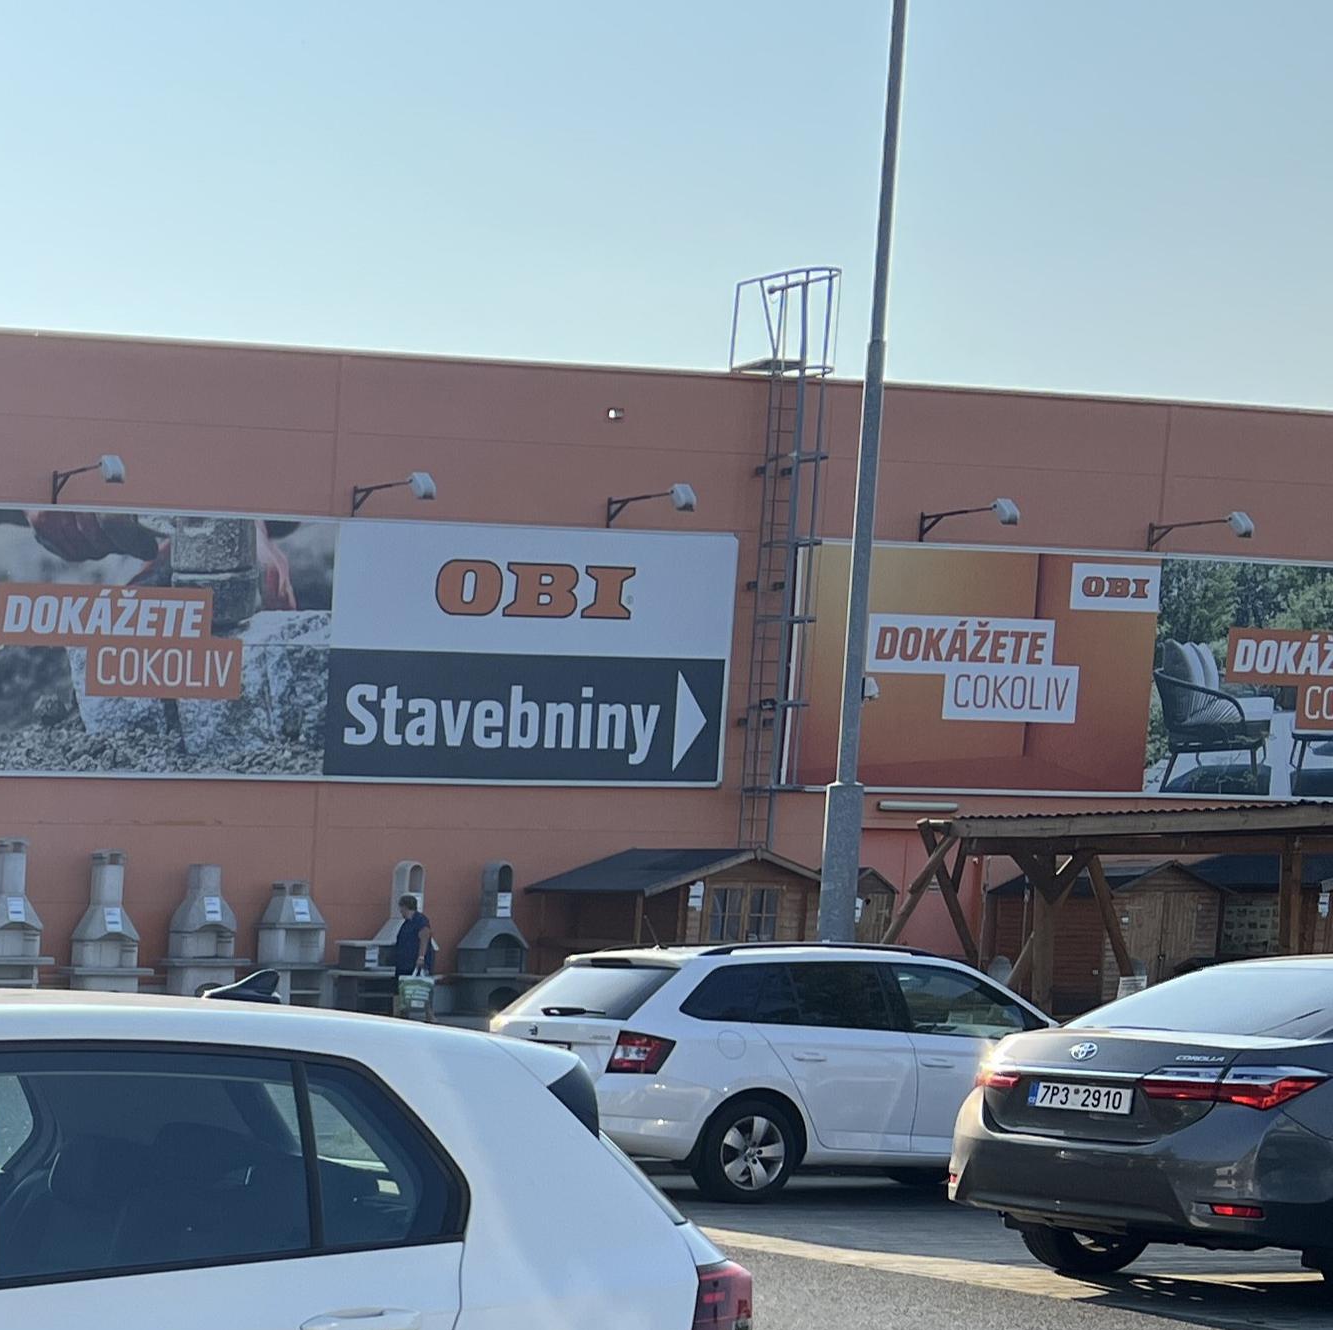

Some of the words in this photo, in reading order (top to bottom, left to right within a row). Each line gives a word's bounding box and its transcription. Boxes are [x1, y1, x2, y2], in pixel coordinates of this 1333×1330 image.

[435, 558, 636, 620] OBI
[1081, 575, 1151, 599] OBI
[2, 588, 206, 638] DOKÁŽETE
[874, 620, 1048, 665] DOKÁŽETE
[95, 646, 234, 688] COKOLIV
[953, 673, 1070, 712] COKOLIV
[343, 683, 662, 766] Stavebniny
[1174, 1055, 1226, 1063] COROLLA
[1038, 1084, 1071, 1106] 7P3
[1080, 1088, 1123, 1110] 2910
